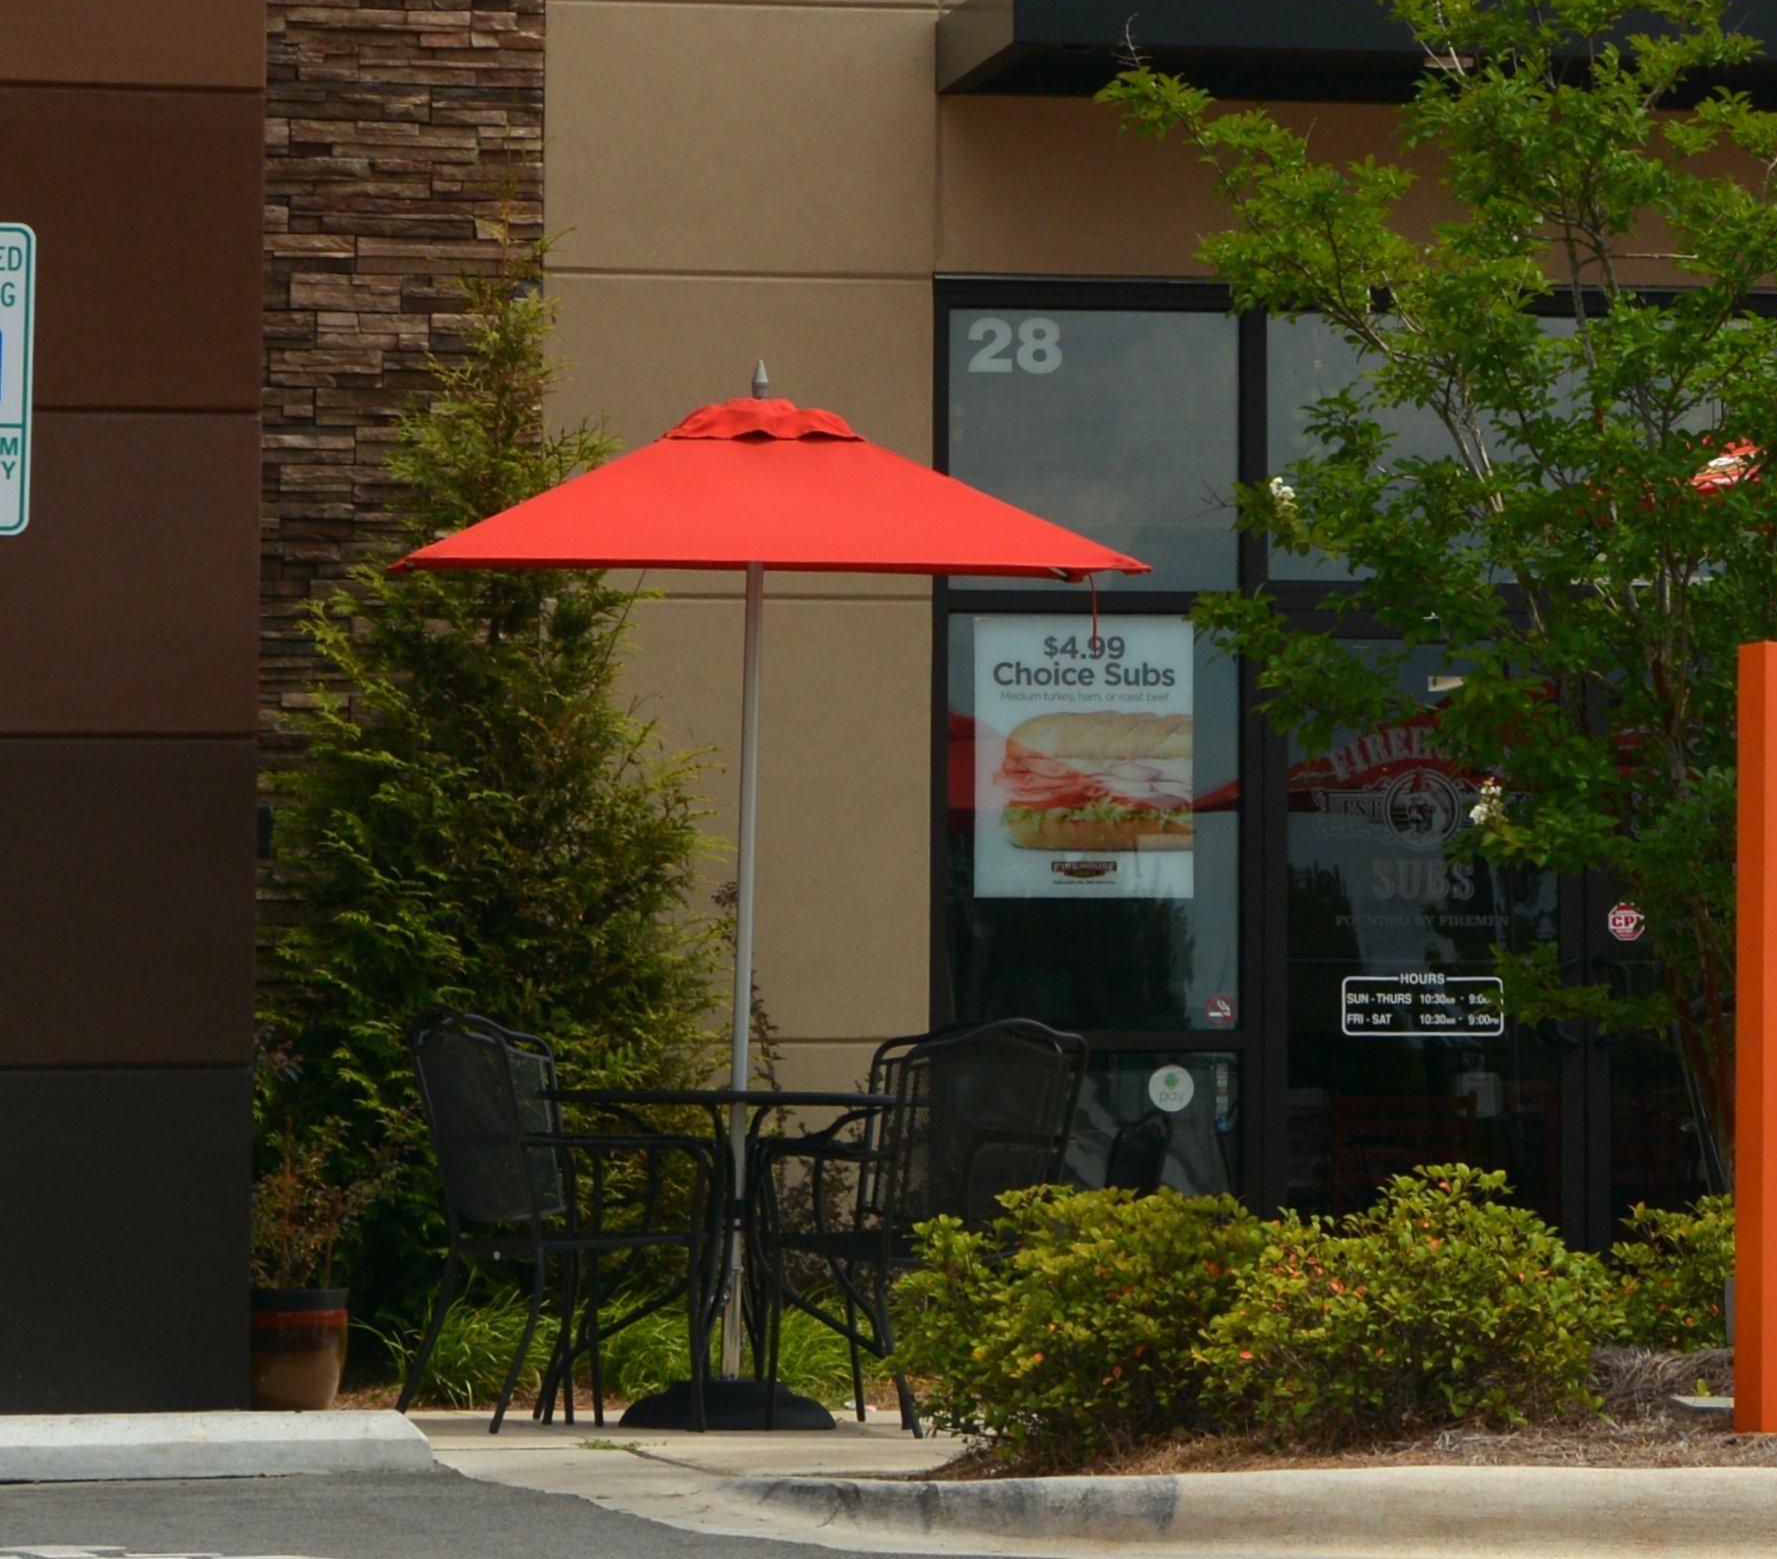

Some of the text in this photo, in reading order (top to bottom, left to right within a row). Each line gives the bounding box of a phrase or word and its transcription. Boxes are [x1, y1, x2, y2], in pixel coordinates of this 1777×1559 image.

[967, 316, 1064, 375] 28
[1043, 635, 1126, 660] $4.99
[992, 661, 1176, 687] Choice Subs
[1372, 859, 1476, 901] SUBS
[1438, 914, 1511, 927] FIREMEN
[1399, 972, 1446, 985] HOURS
[1346, 993, 1369, 1005] SUN
[1376, 993, 1413, 1005] THURS
[1346, 1014, 1364, 1025] FRI
[1372, 1014, 1392, 1025] SAT
